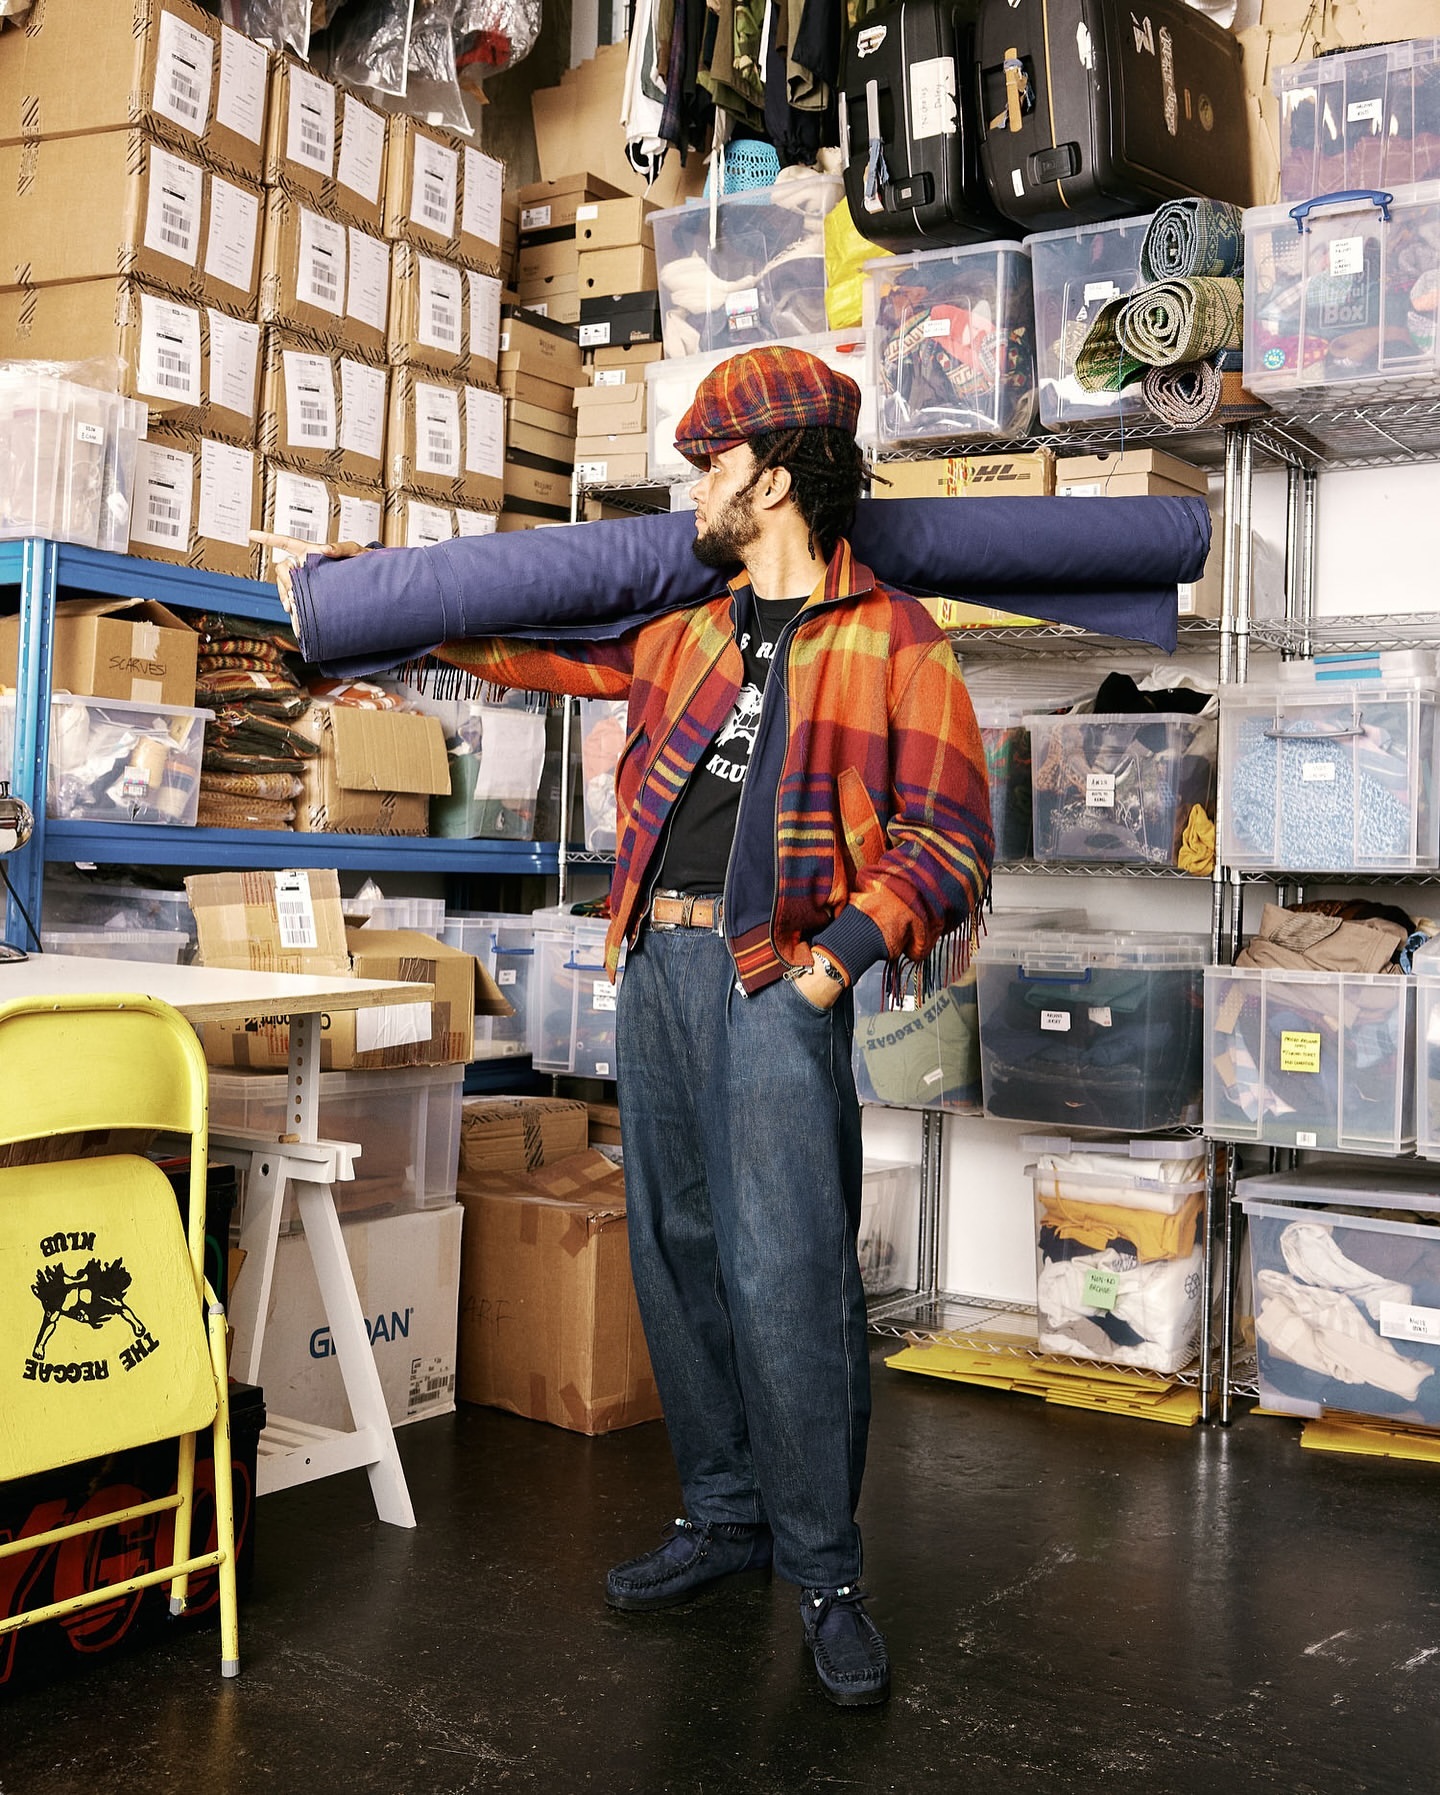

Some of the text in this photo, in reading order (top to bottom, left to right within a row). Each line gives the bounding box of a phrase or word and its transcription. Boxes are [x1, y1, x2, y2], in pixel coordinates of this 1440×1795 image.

[969, 464, 1018, 483] HL
[705, 754, 748, 782] KLU
[866, 995, 950, 1051] THE REGGAE
[40, 1231, 96, 1258] KLUB
[22, 1332, 160, 1384] THE REGGAE
